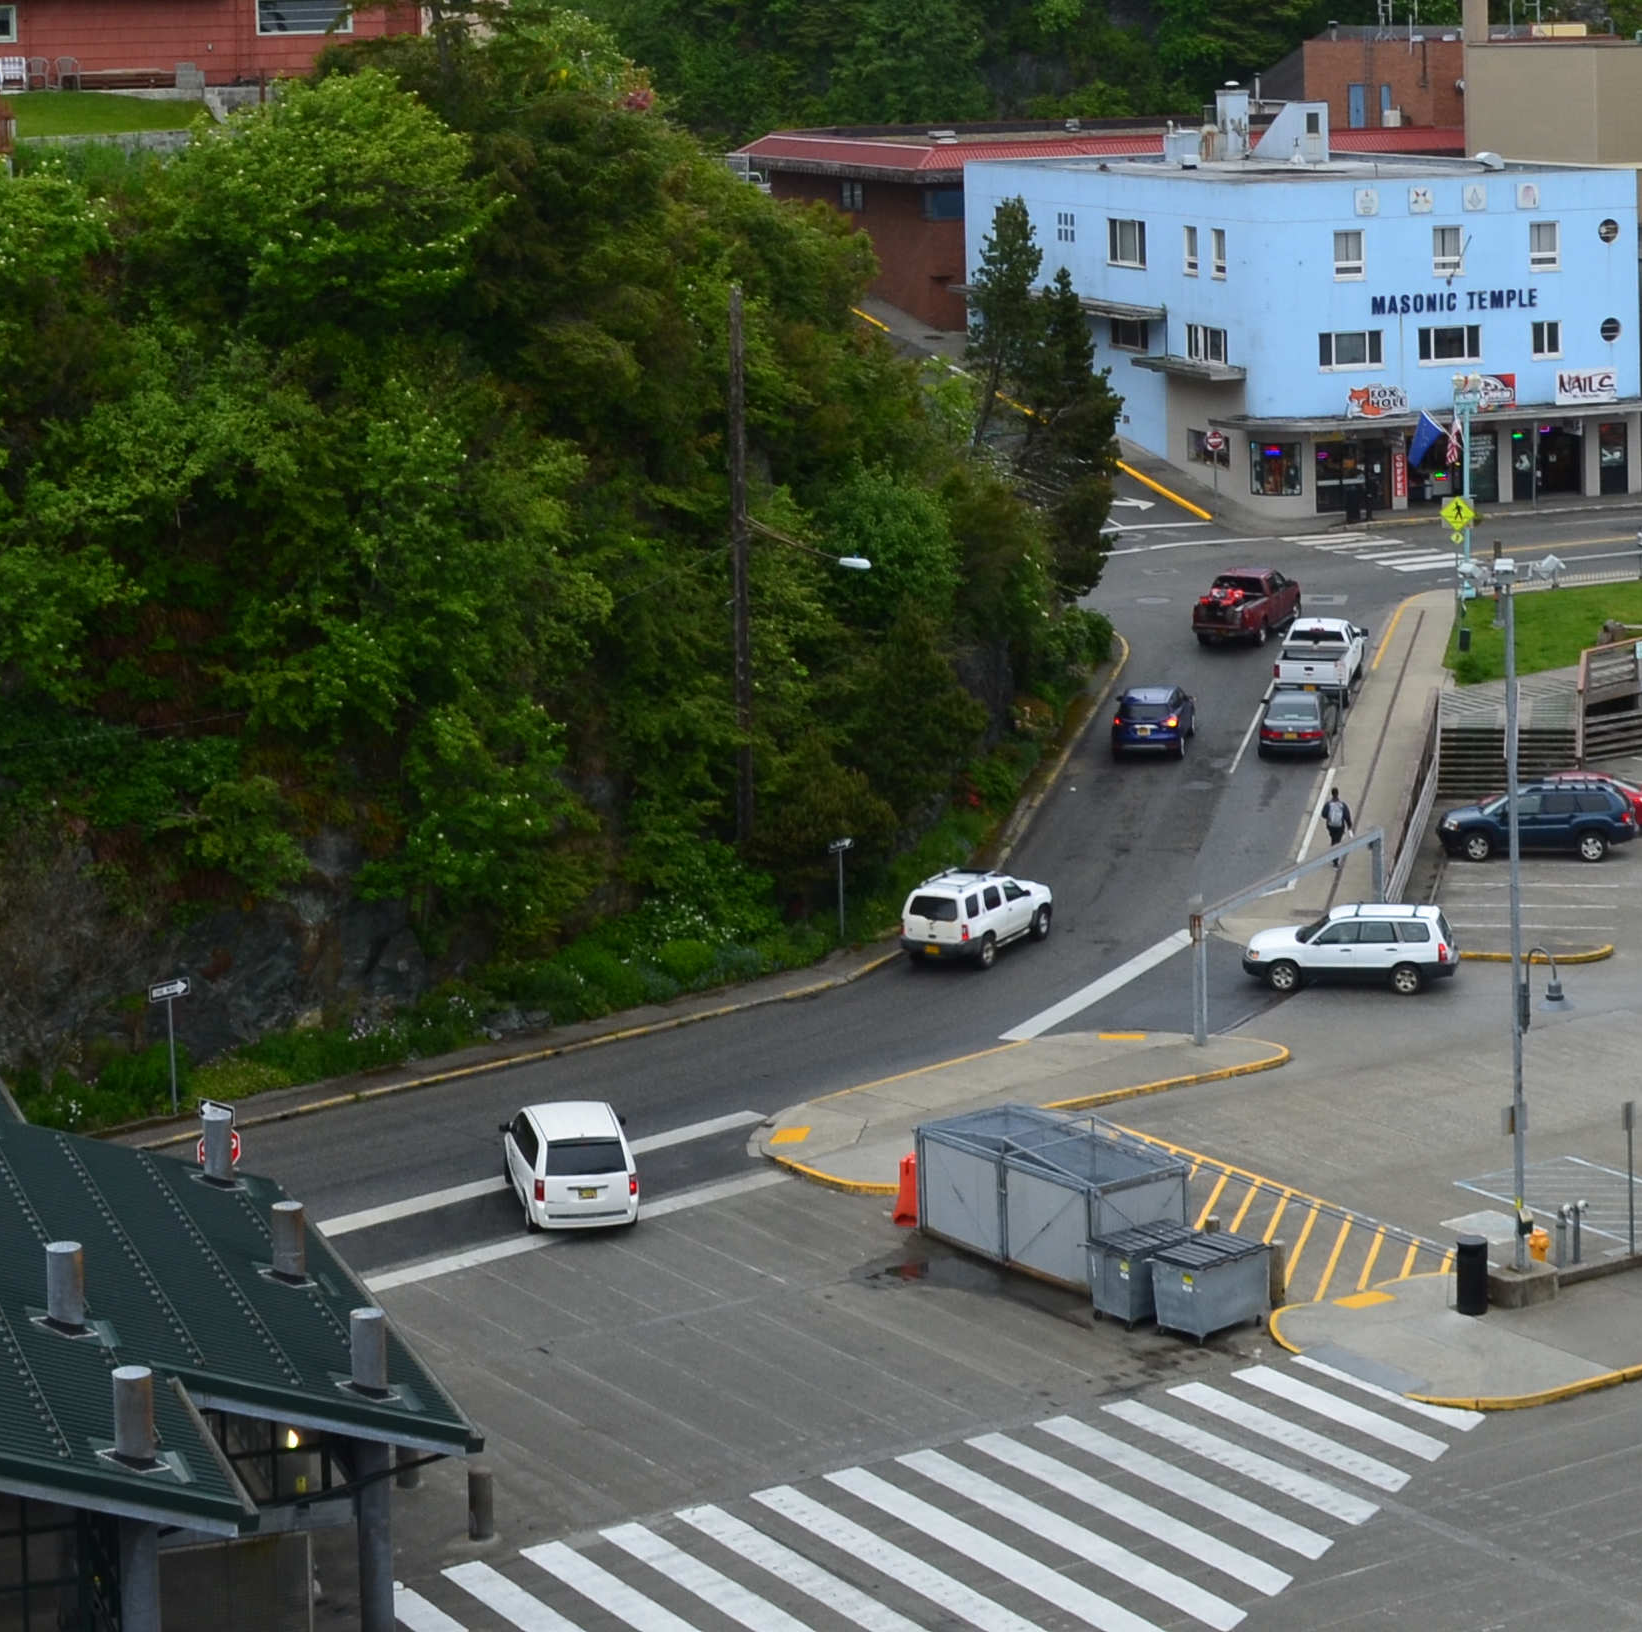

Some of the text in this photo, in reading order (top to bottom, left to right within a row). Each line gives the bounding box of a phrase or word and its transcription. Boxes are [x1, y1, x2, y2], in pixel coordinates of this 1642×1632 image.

[1371, 288, 1537, 315] MASONIC TEMPLE
[1559, 372, 1615, 393] NAILS
[1371, 389, 1397, 398] FOX
[1371, 398, 1405, 407] HOLE
